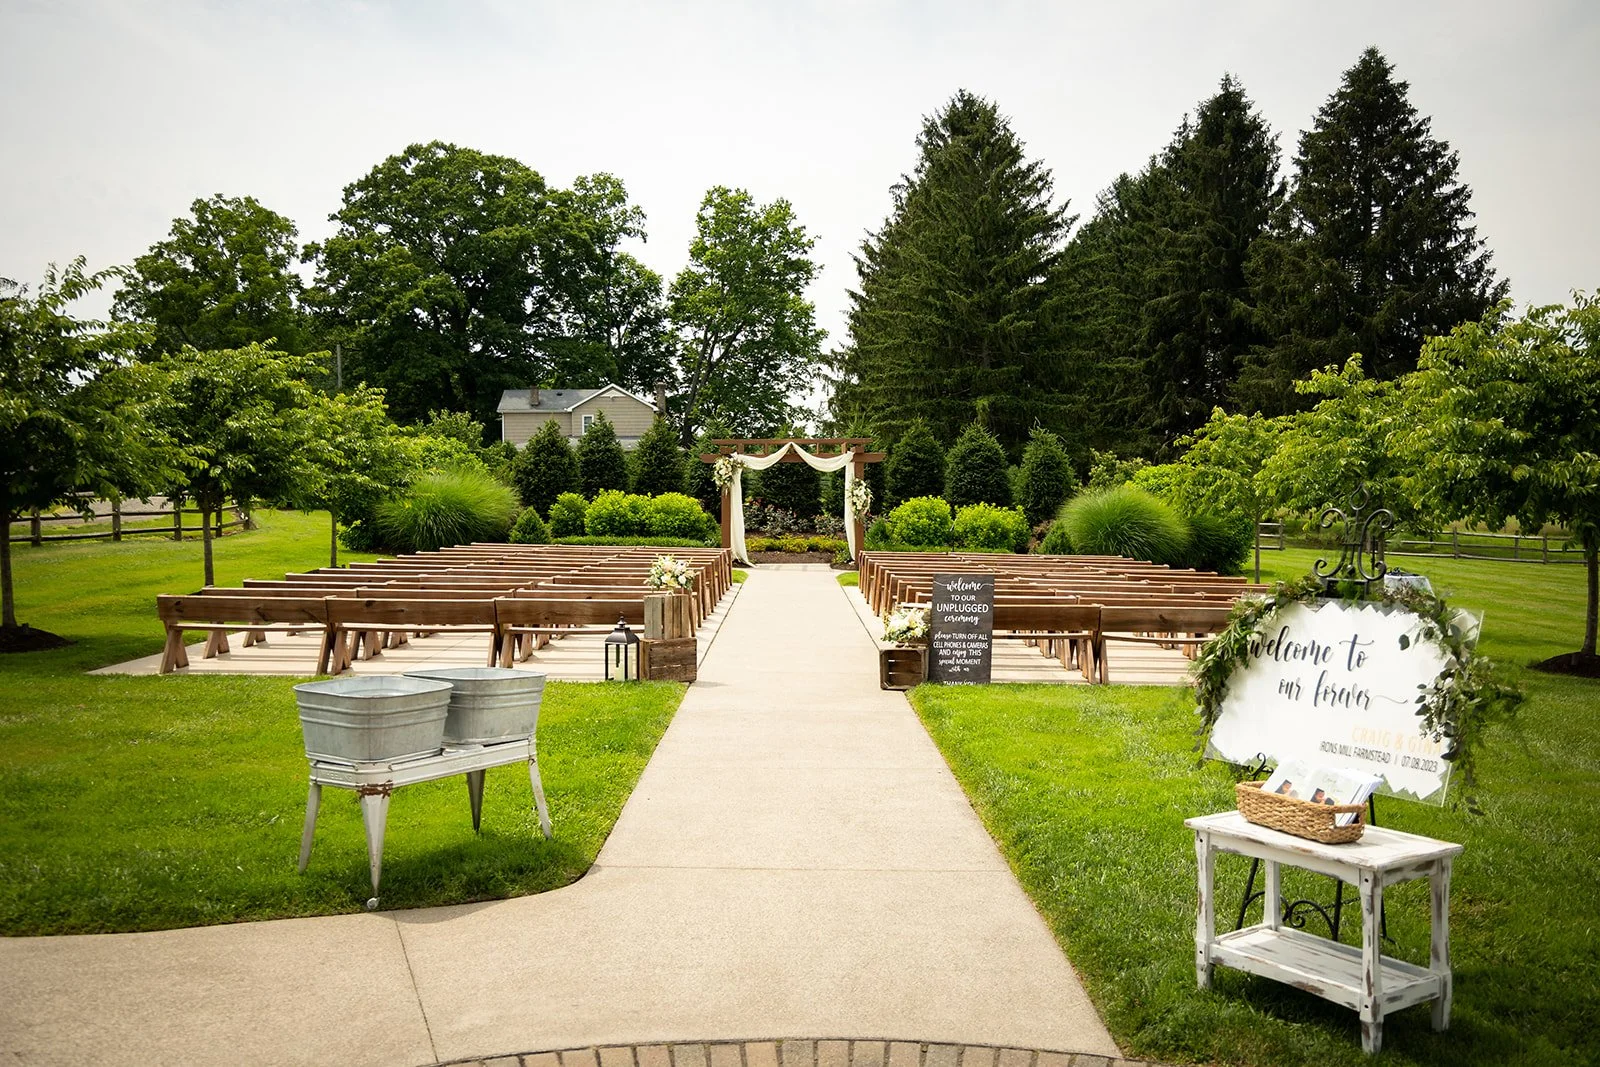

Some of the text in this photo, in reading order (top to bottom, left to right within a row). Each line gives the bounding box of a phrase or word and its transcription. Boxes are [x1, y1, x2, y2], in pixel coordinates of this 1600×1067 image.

[943, 577, 984, 592] welcome
[936, 603, 989, 613] UNPLUGGED
[944, 614, 980, 626] ceremony
[944, 641, 962, 649] PHONES
[1249, 625, 1375, 672] welcome to
[1278, 670, 1405, 711] our forever
[1351, 726, 1391, 748] CRAIG
[1352, 746, 1391, 764] FARMSTEAD
[1400, 755, 1439, 773] 07.08.2023
